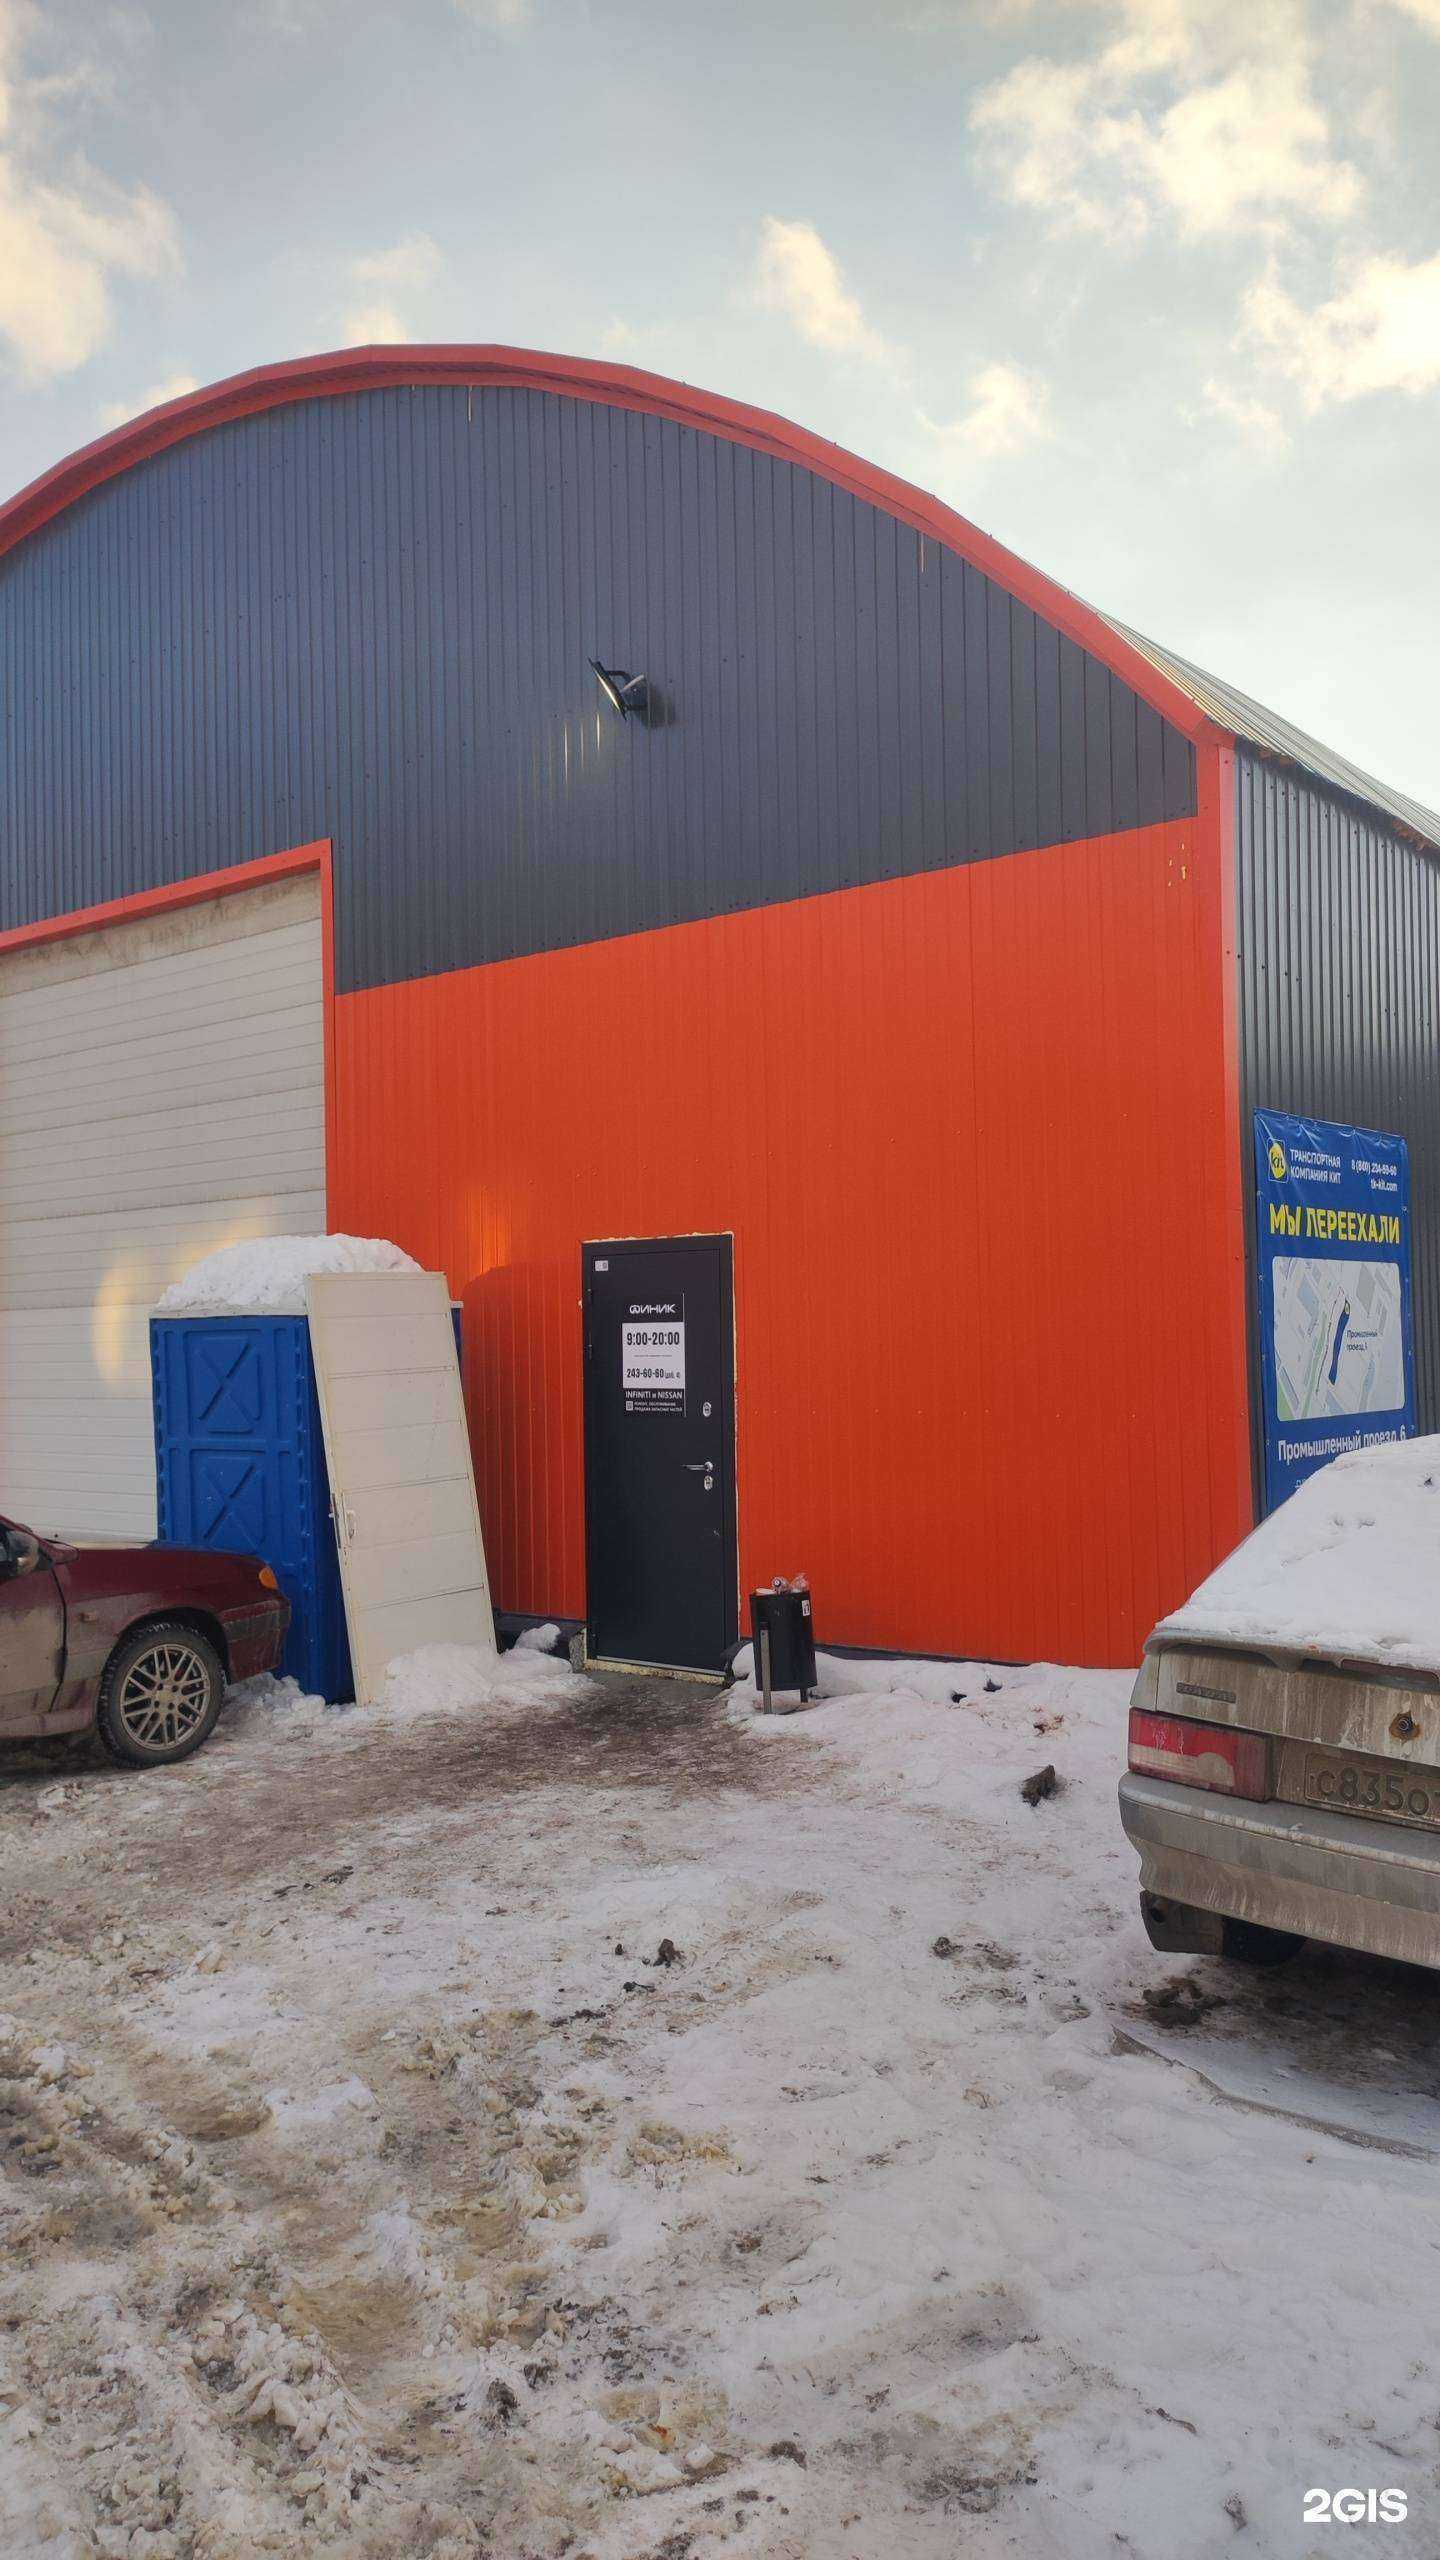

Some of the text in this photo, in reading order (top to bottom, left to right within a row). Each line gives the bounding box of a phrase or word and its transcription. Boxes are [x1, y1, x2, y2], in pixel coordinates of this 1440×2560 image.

[1289, 1148, 1341, 1169] ТРАНСПОРТНАЯ
[1290, 1165, 1341, 1185] КОМПАНИЯ КИТ
[1269, 1202, 1400, 1244] МЫ ПЕРЕЕХАЛИ
[629, 1303, 676, 1315] ФИНИК
[626, 1331, 680, 1346] 9:00-20:00
[625, 1390, 651, 1400] INFINITI
[657, 1391, 683, 1400] NISSAN
[1278, 1429, 1362, 1466] Промышленный
